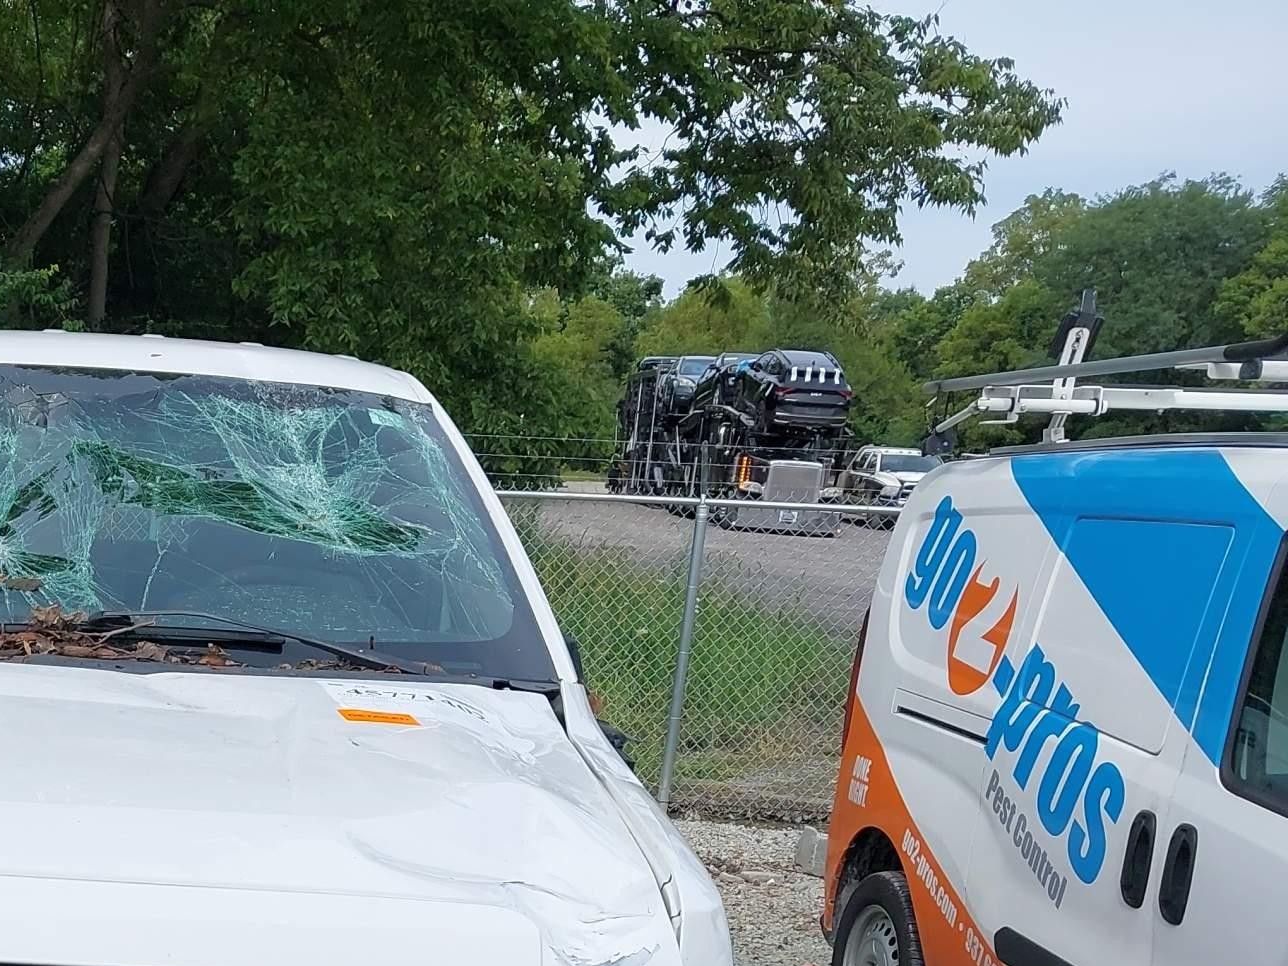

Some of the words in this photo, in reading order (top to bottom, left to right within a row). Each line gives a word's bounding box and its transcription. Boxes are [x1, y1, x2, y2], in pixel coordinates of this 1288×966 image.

[901, 829, 957, 928] go2-pros.com
[985, 769, 1016, 834] Pest
[1013, 813, 1067, 910] Control
